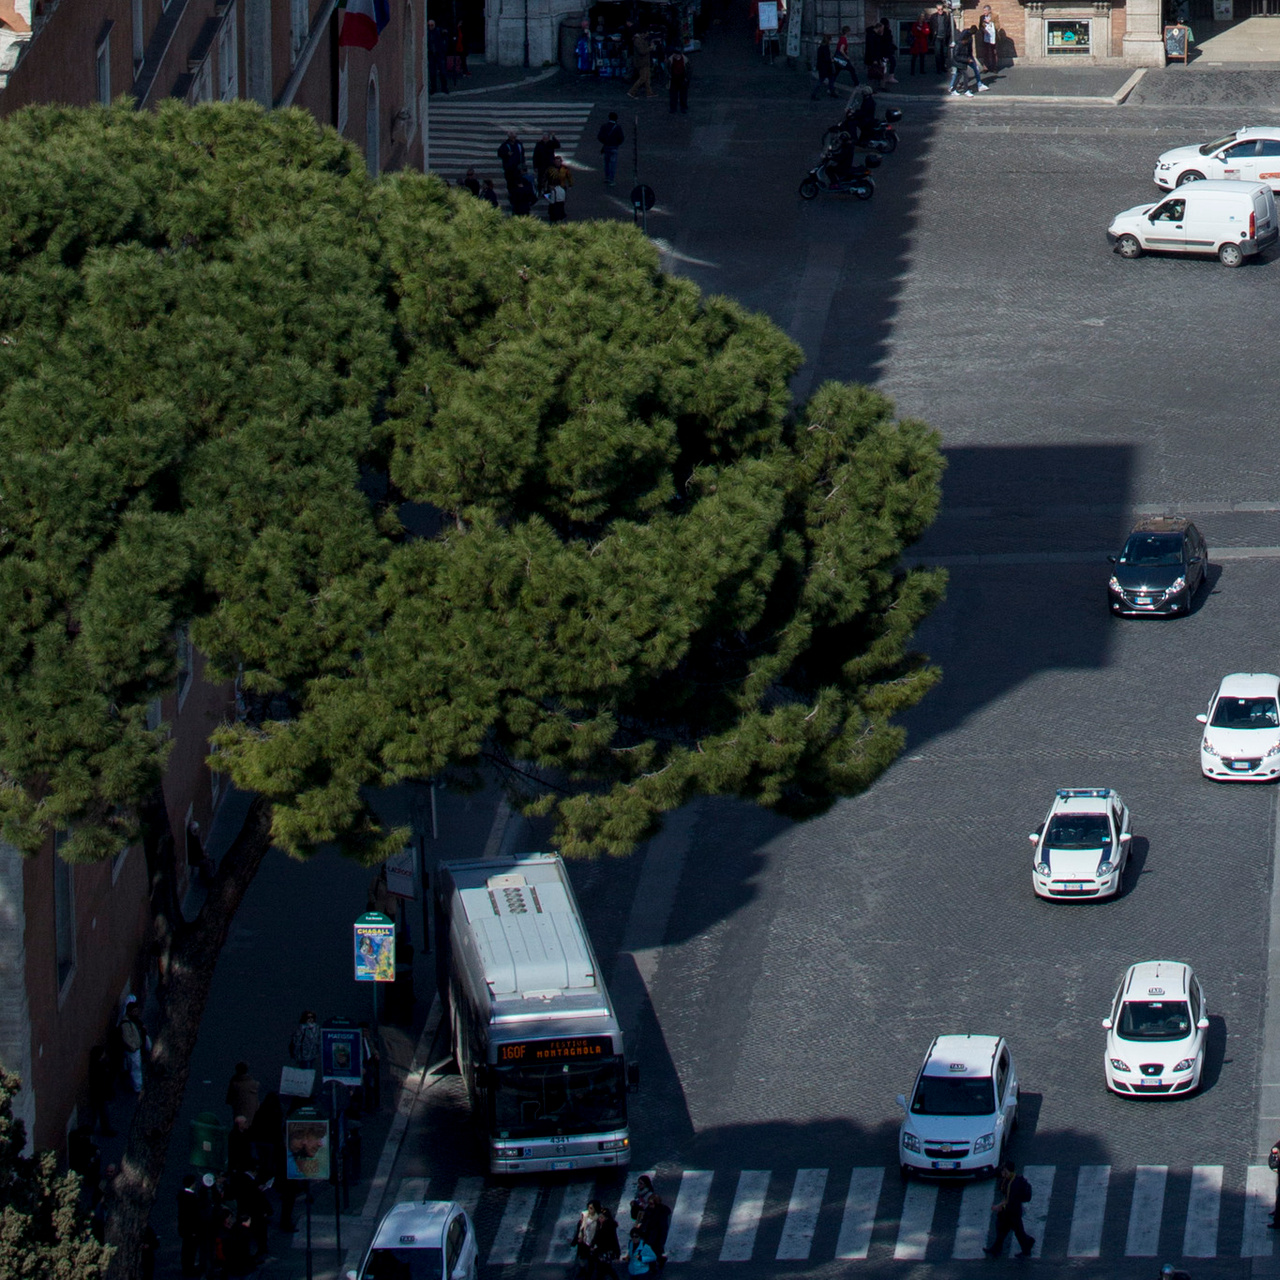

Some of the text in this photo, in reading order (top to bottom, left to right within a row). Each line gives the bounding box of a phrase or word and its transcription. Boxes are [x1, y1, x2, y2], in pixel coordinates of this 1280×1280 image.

[327, 1032, 356, 1040] MATISSE
[501, 1045, 602, 1060] 160F MONTAGNOLA
[550, 1136, 570, 1144] 4341
